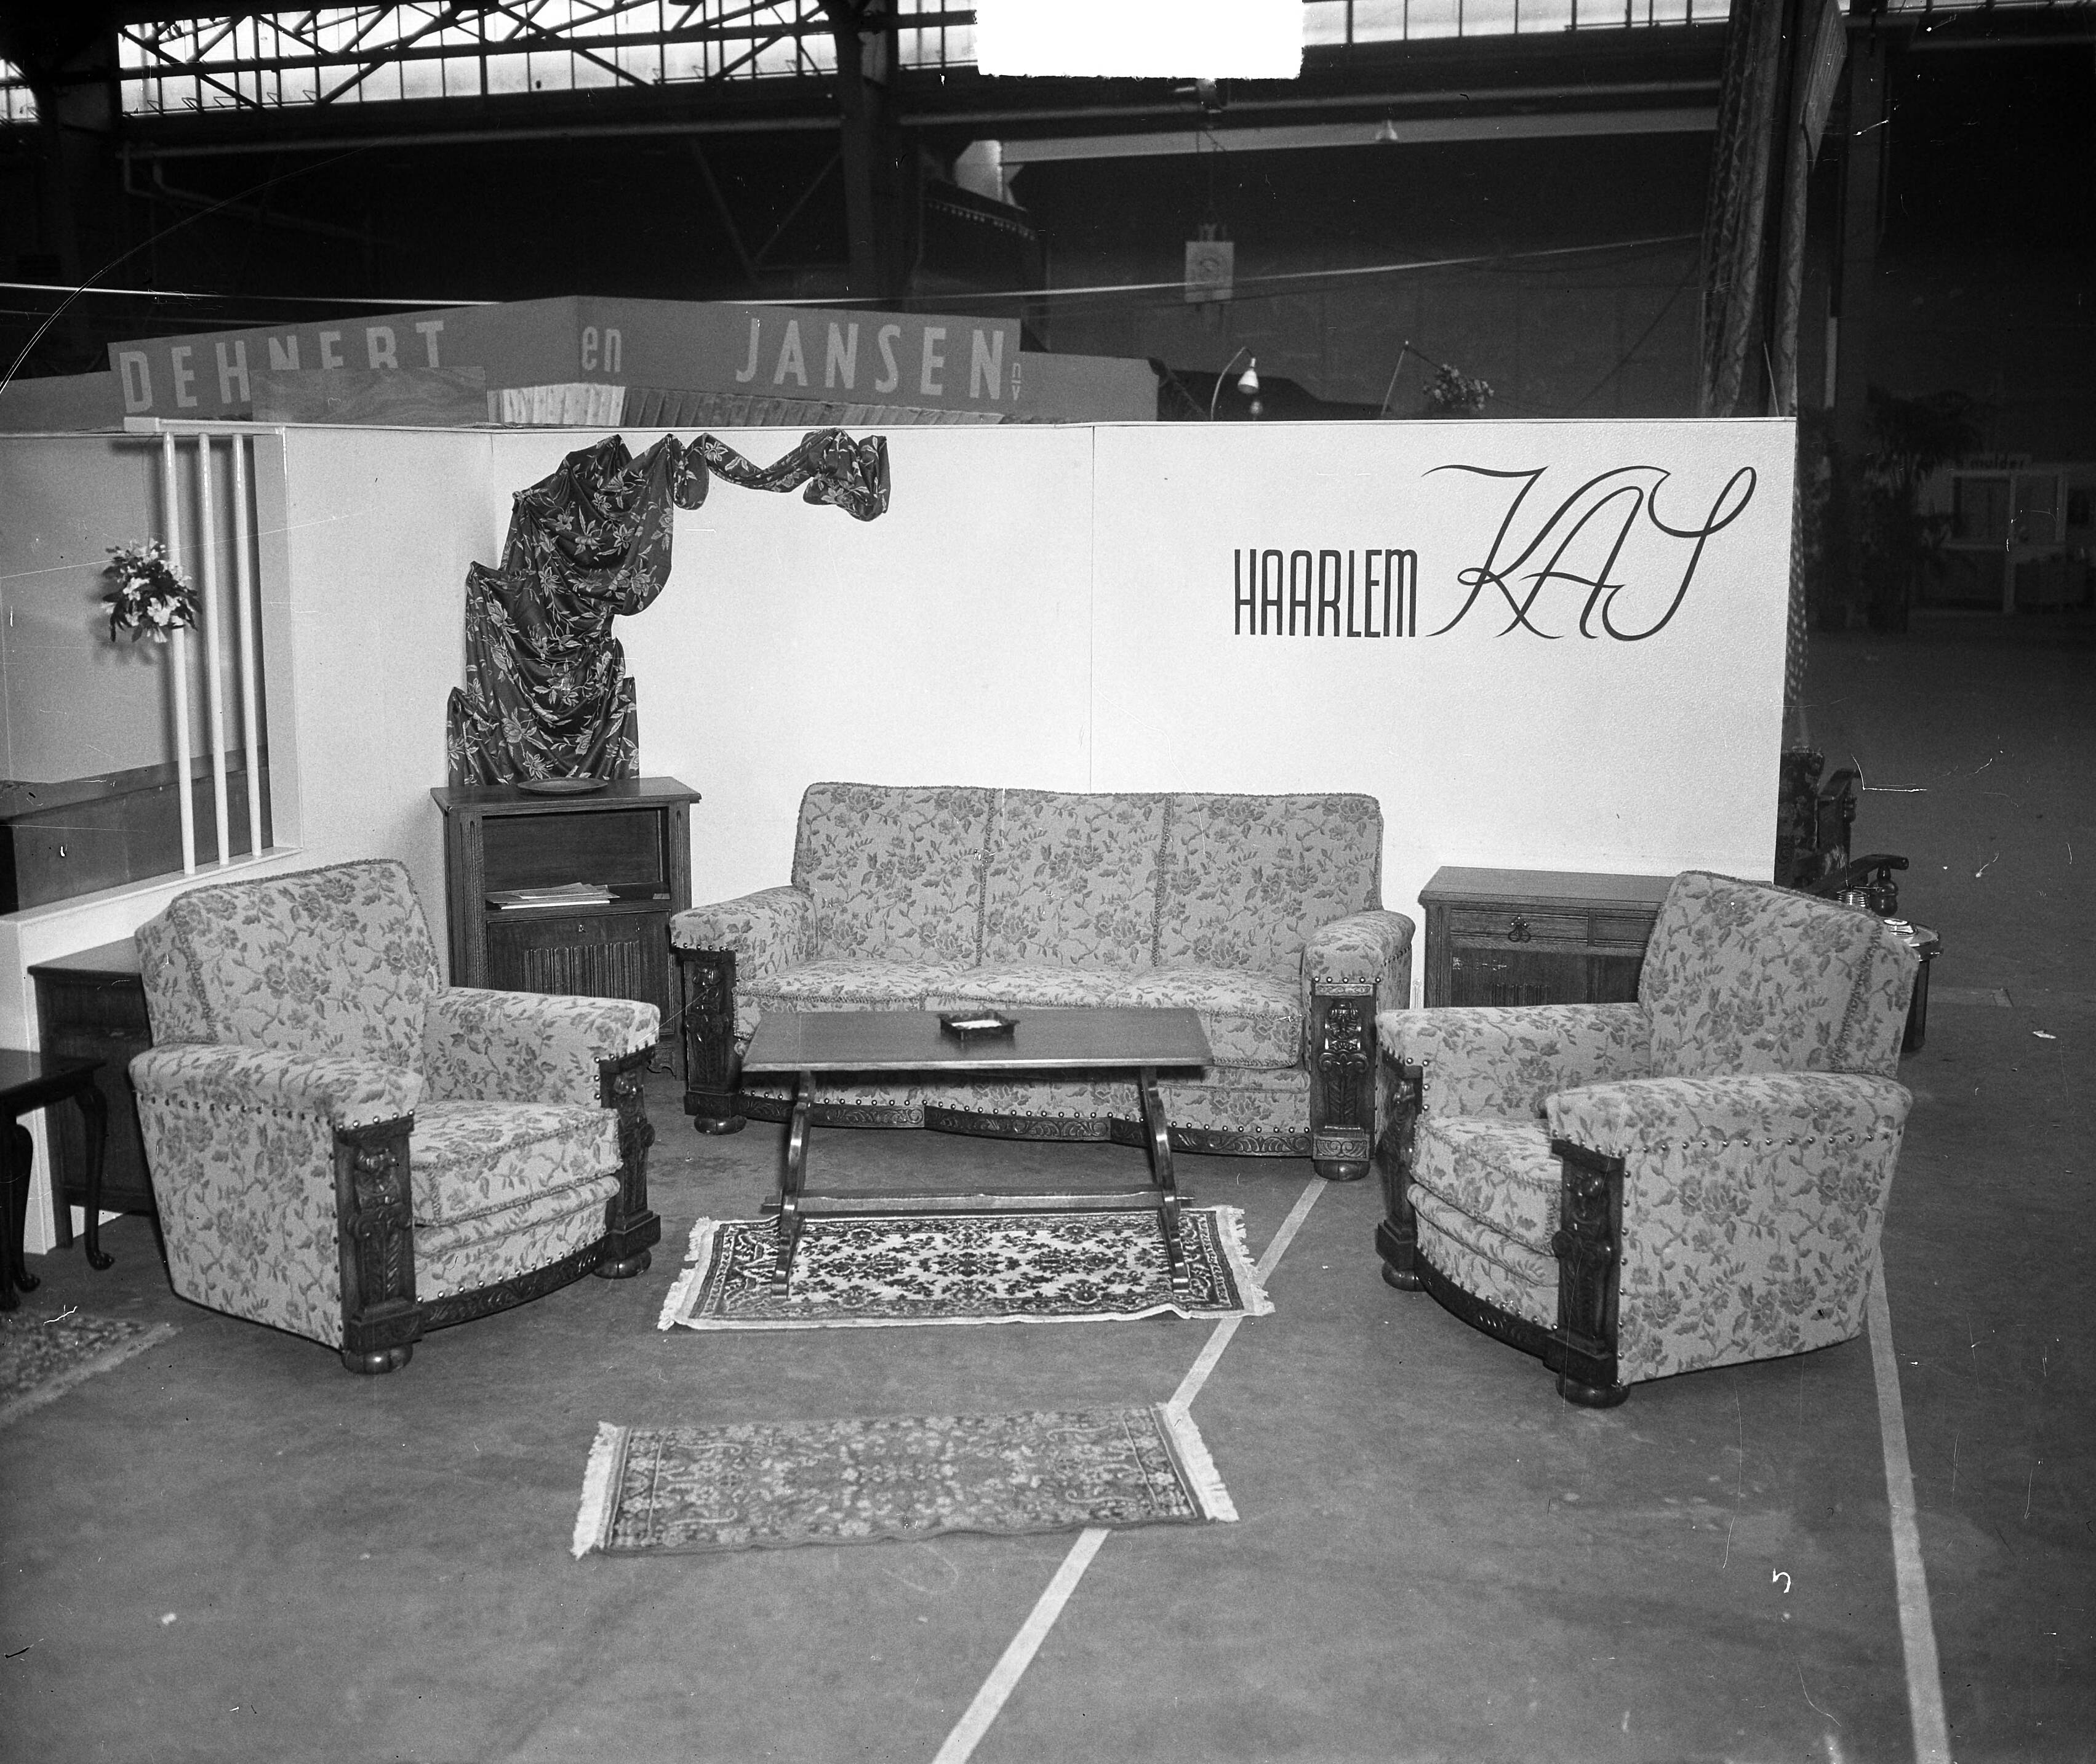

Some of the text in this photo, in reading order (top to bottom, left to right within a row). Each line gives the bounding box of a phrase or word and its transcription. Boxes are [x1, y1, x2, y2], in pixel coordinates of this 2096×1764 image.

[119, 320, 444, 414] DEHNERT
[581, 326, 622, 372] en
[735, 318, 1004, 400] JANSEN
[1234, 549, 1418, 638] HAARLEM
